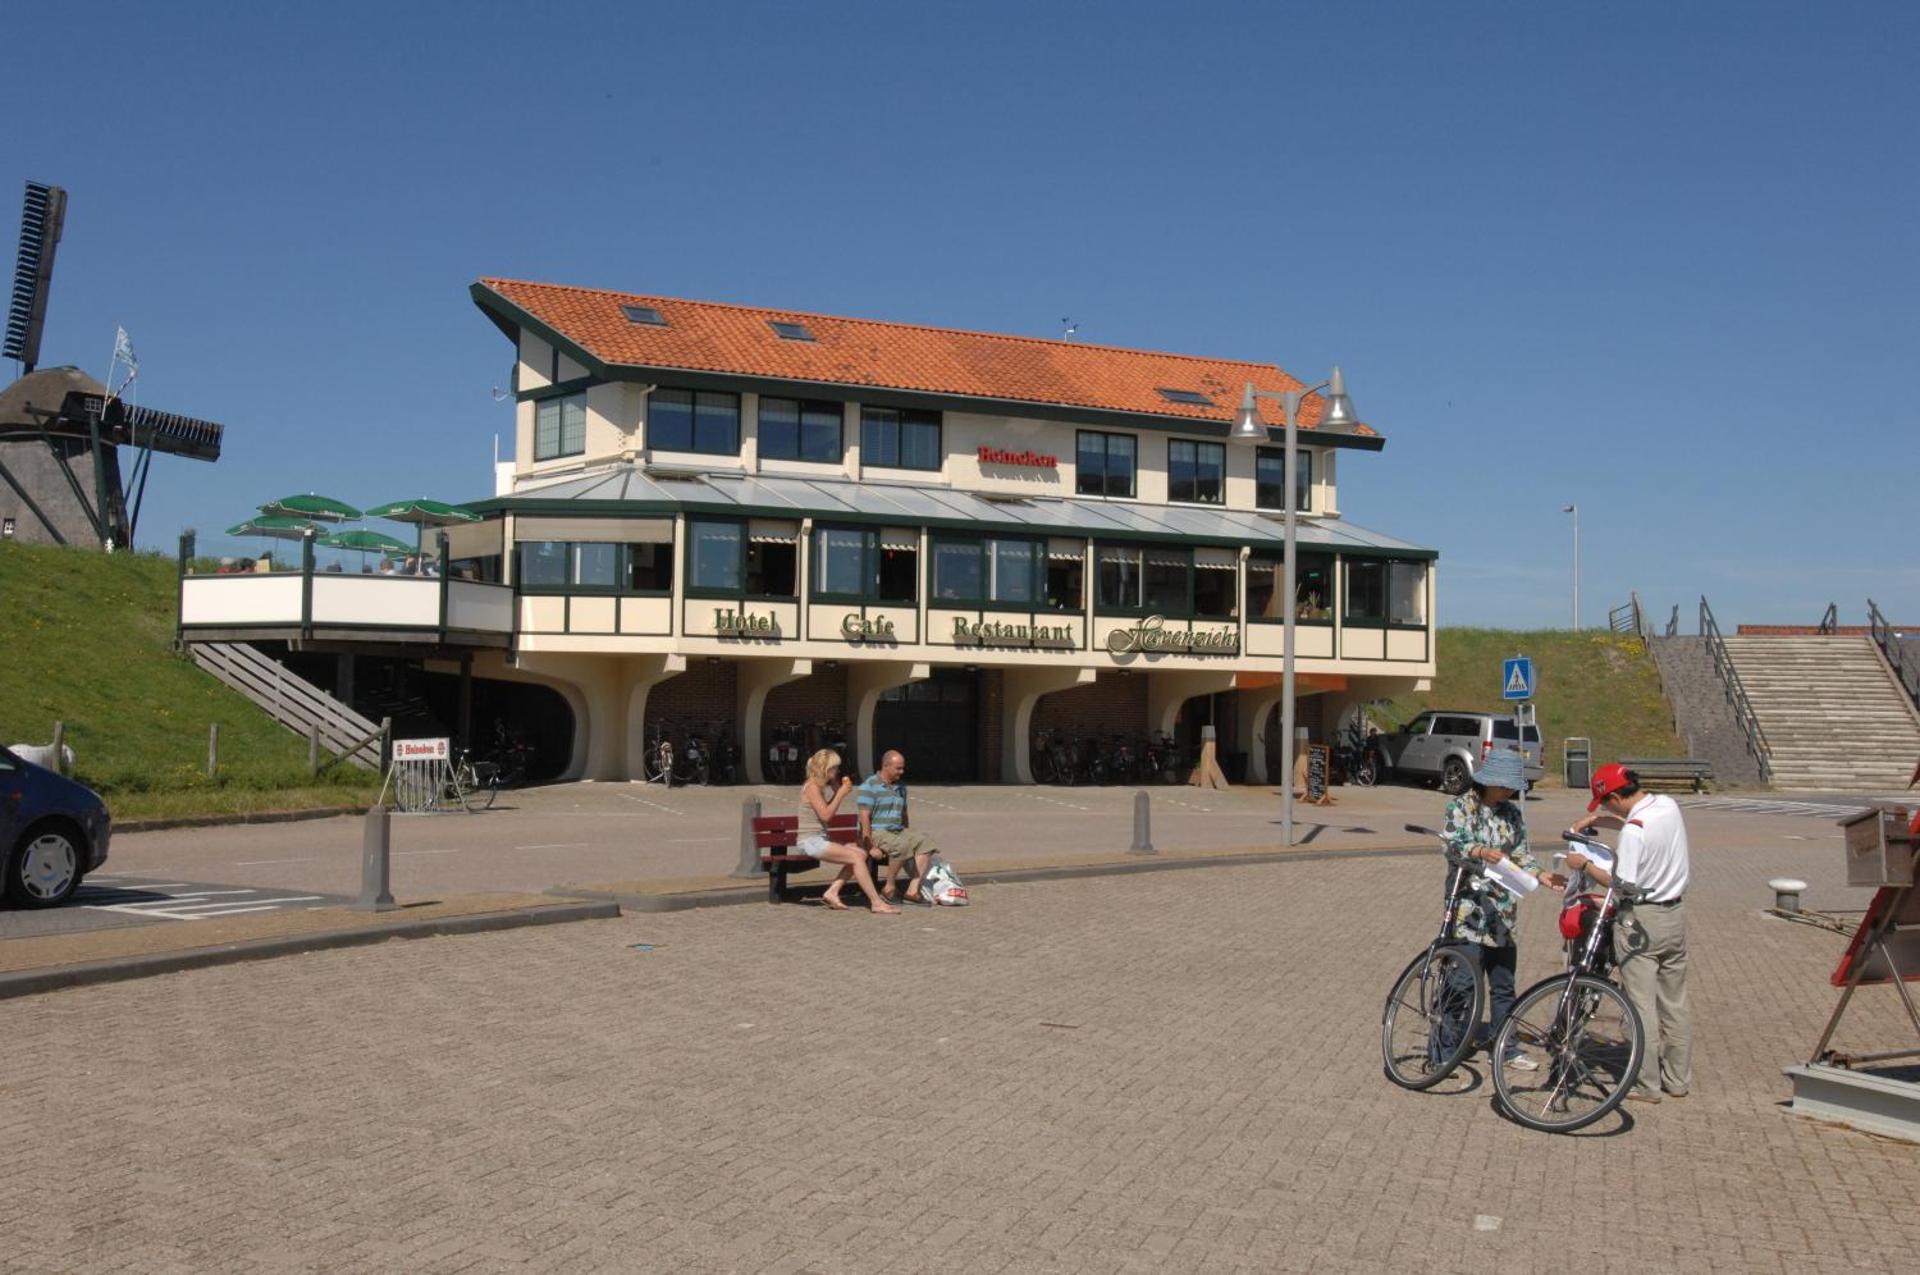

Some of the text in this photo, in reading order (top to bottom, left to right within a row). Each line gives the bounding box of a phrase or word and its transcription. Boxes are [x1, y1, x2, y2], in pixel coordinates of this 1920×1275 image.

[977, 446, 1057, 468] Heineken
[714, 608, 776, 630] Hotel
[842, 613, 894, 634] Cafe
[952, 616, 1073, 640] Restaurant
